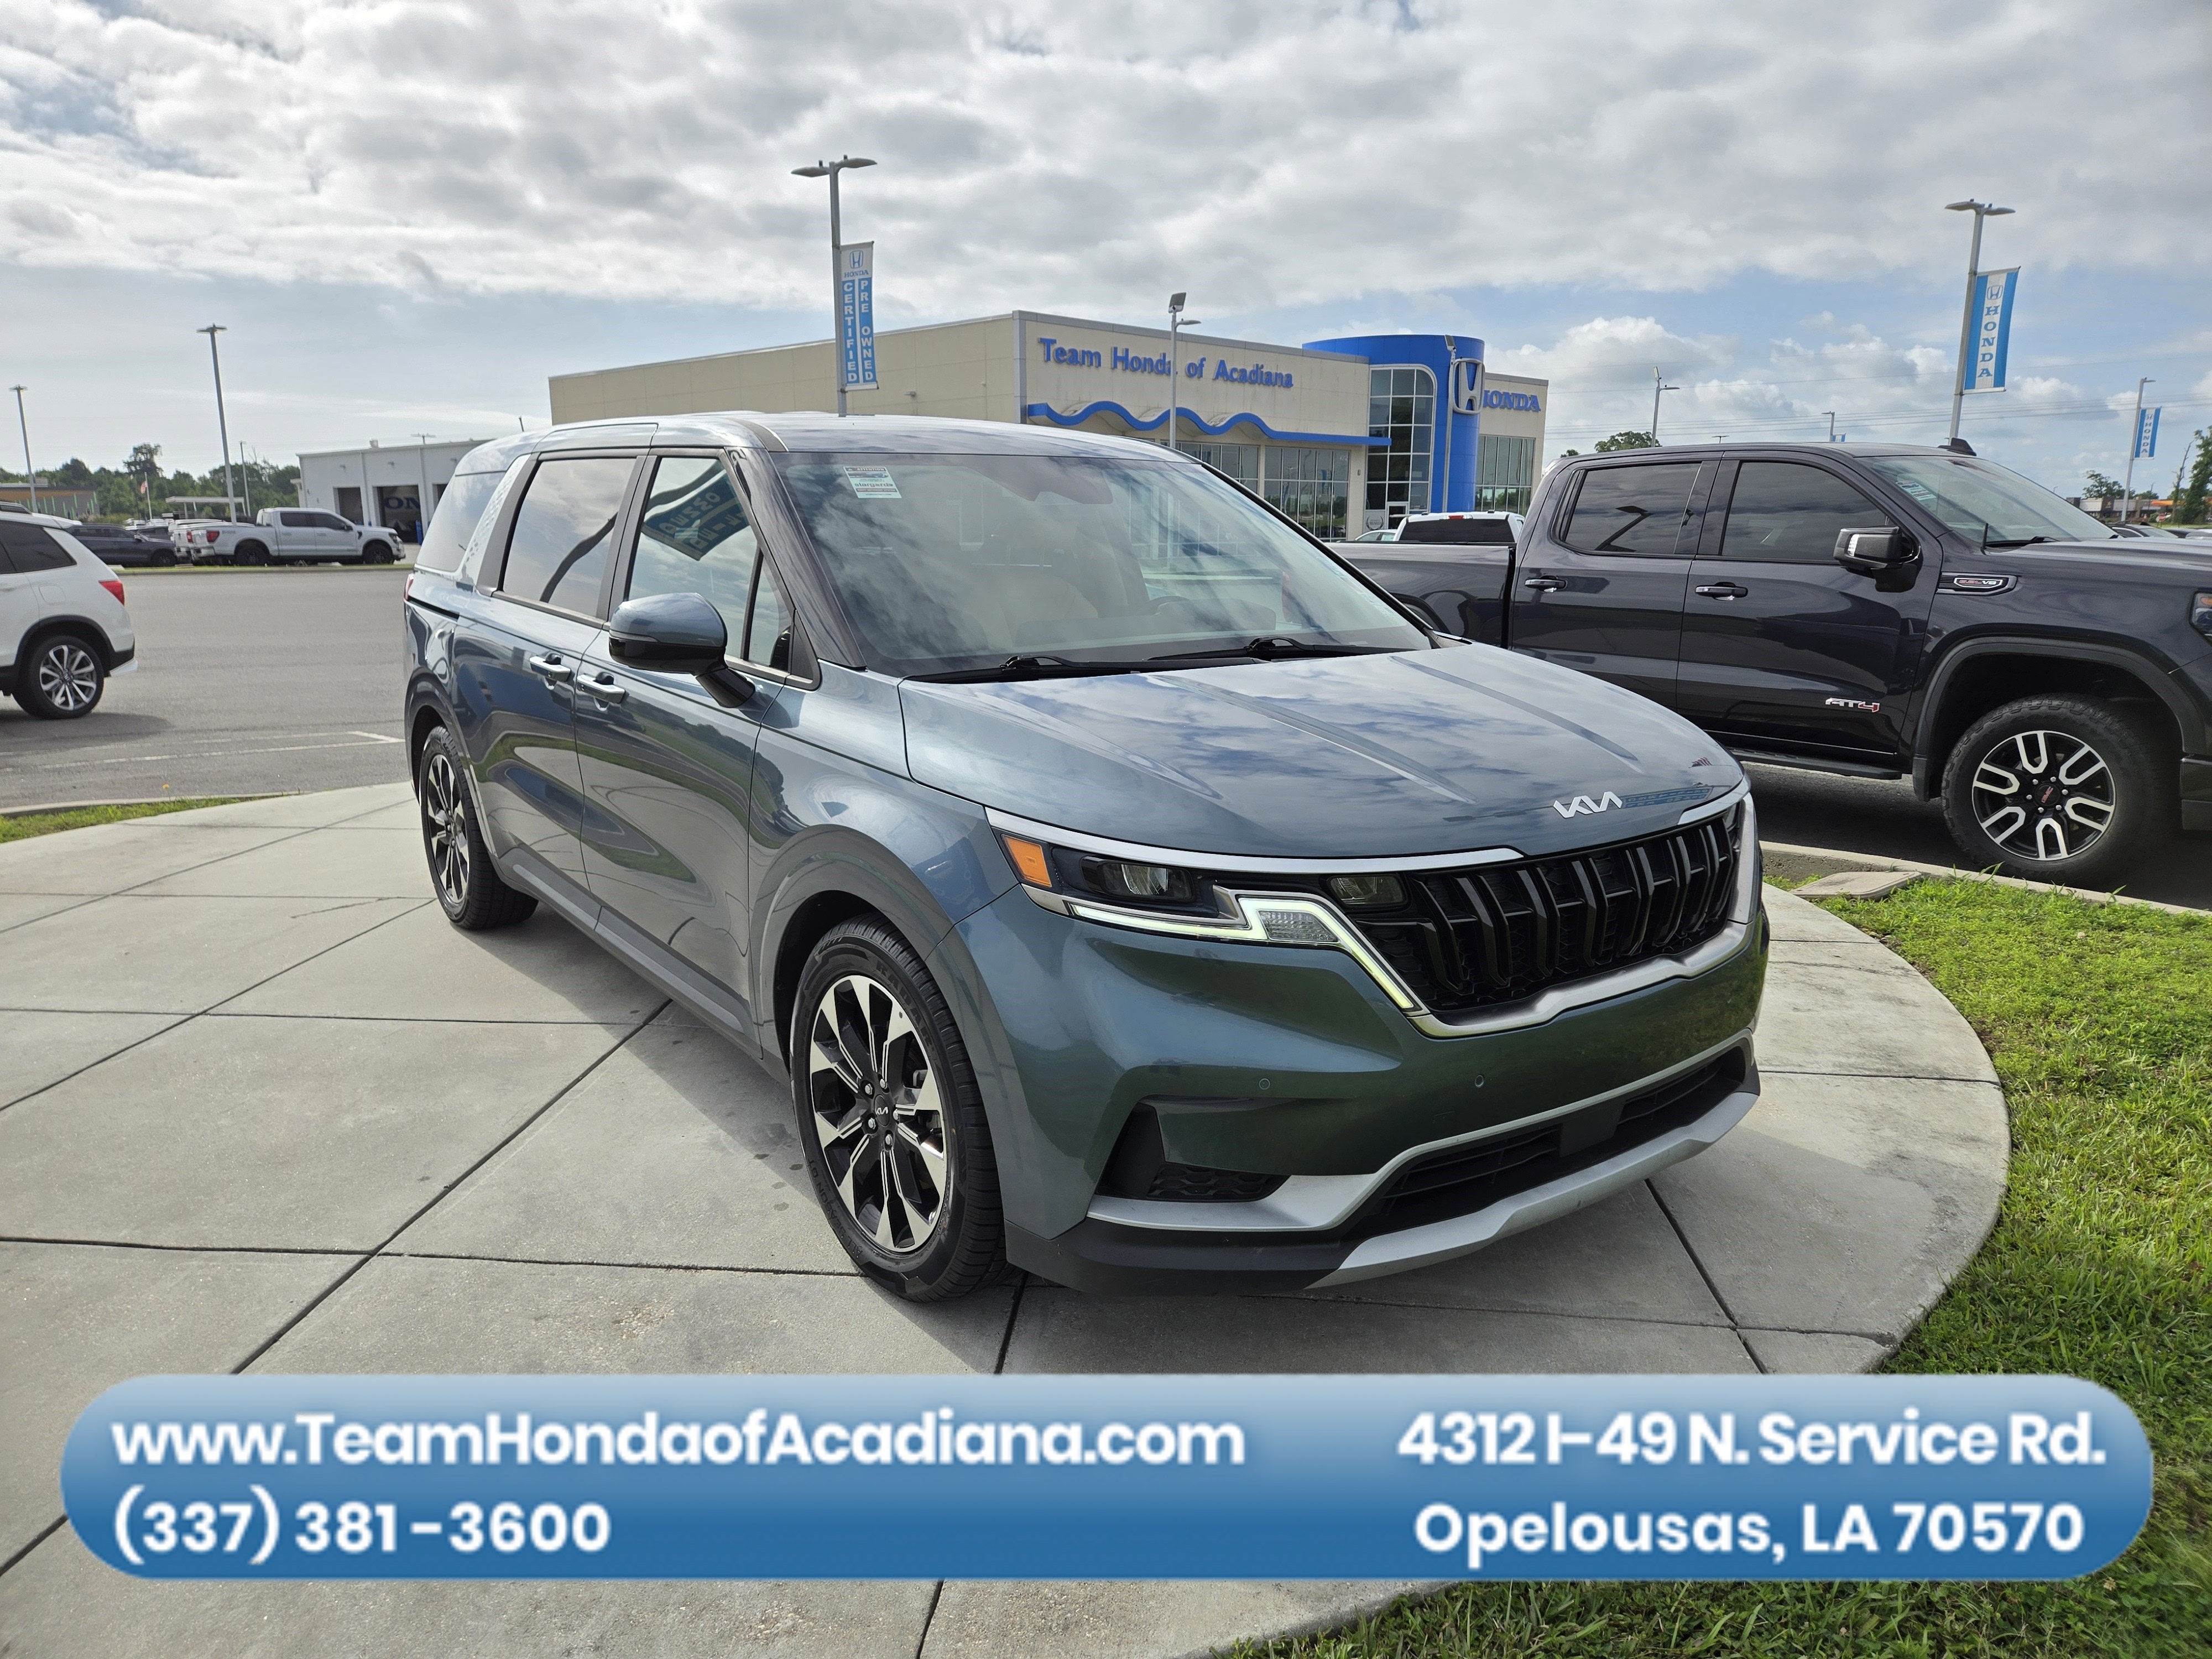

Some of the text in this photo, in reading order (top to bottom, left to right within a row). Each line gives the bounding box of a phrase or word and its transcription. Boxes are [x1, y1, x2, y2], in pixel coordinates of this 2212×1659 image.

[843, 281, 858, 382] CERTIFIED
[860, 280, 873, 380] PRE OWNED
[1978, 305, 2000, 378] HONDA
[1039, 337, 1102, 368] Team
[1186, 357, 1207, 378] of
[1214, 359, 1293, 388] Acadiana
[2141, 422, 2152, 453] HONDA
[1825, 697, 1880, 713] AT4
